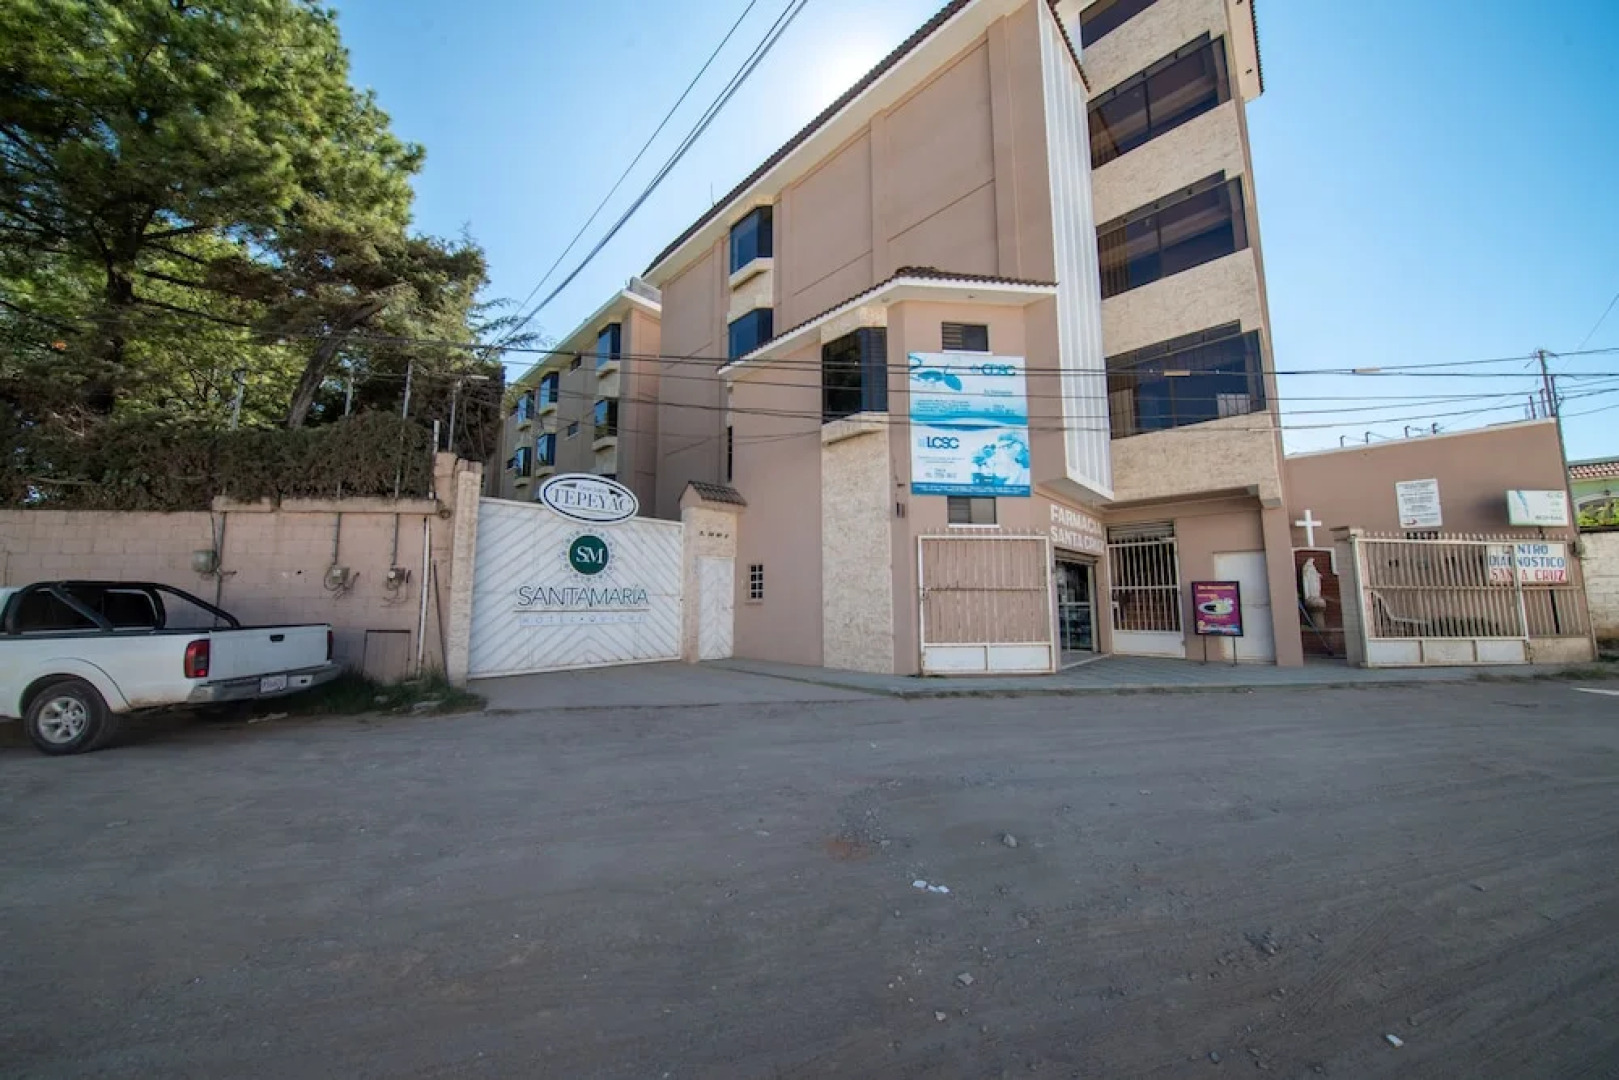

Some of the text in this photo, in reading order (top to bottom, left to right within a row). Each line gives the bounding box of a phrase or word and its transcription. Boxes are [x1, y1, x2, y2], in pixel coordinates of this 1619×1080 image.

[927, 436, 959, 449] LCSC
[554, 487, 632, 512] TEPEYAC
[1050, 503, 1102, 535] FARMACIA
[1050, 525, 1083, 548] SANTA
[575, 546, 605, 563] SM
[1490, 568, 1564, 582] SANA CRUZ
